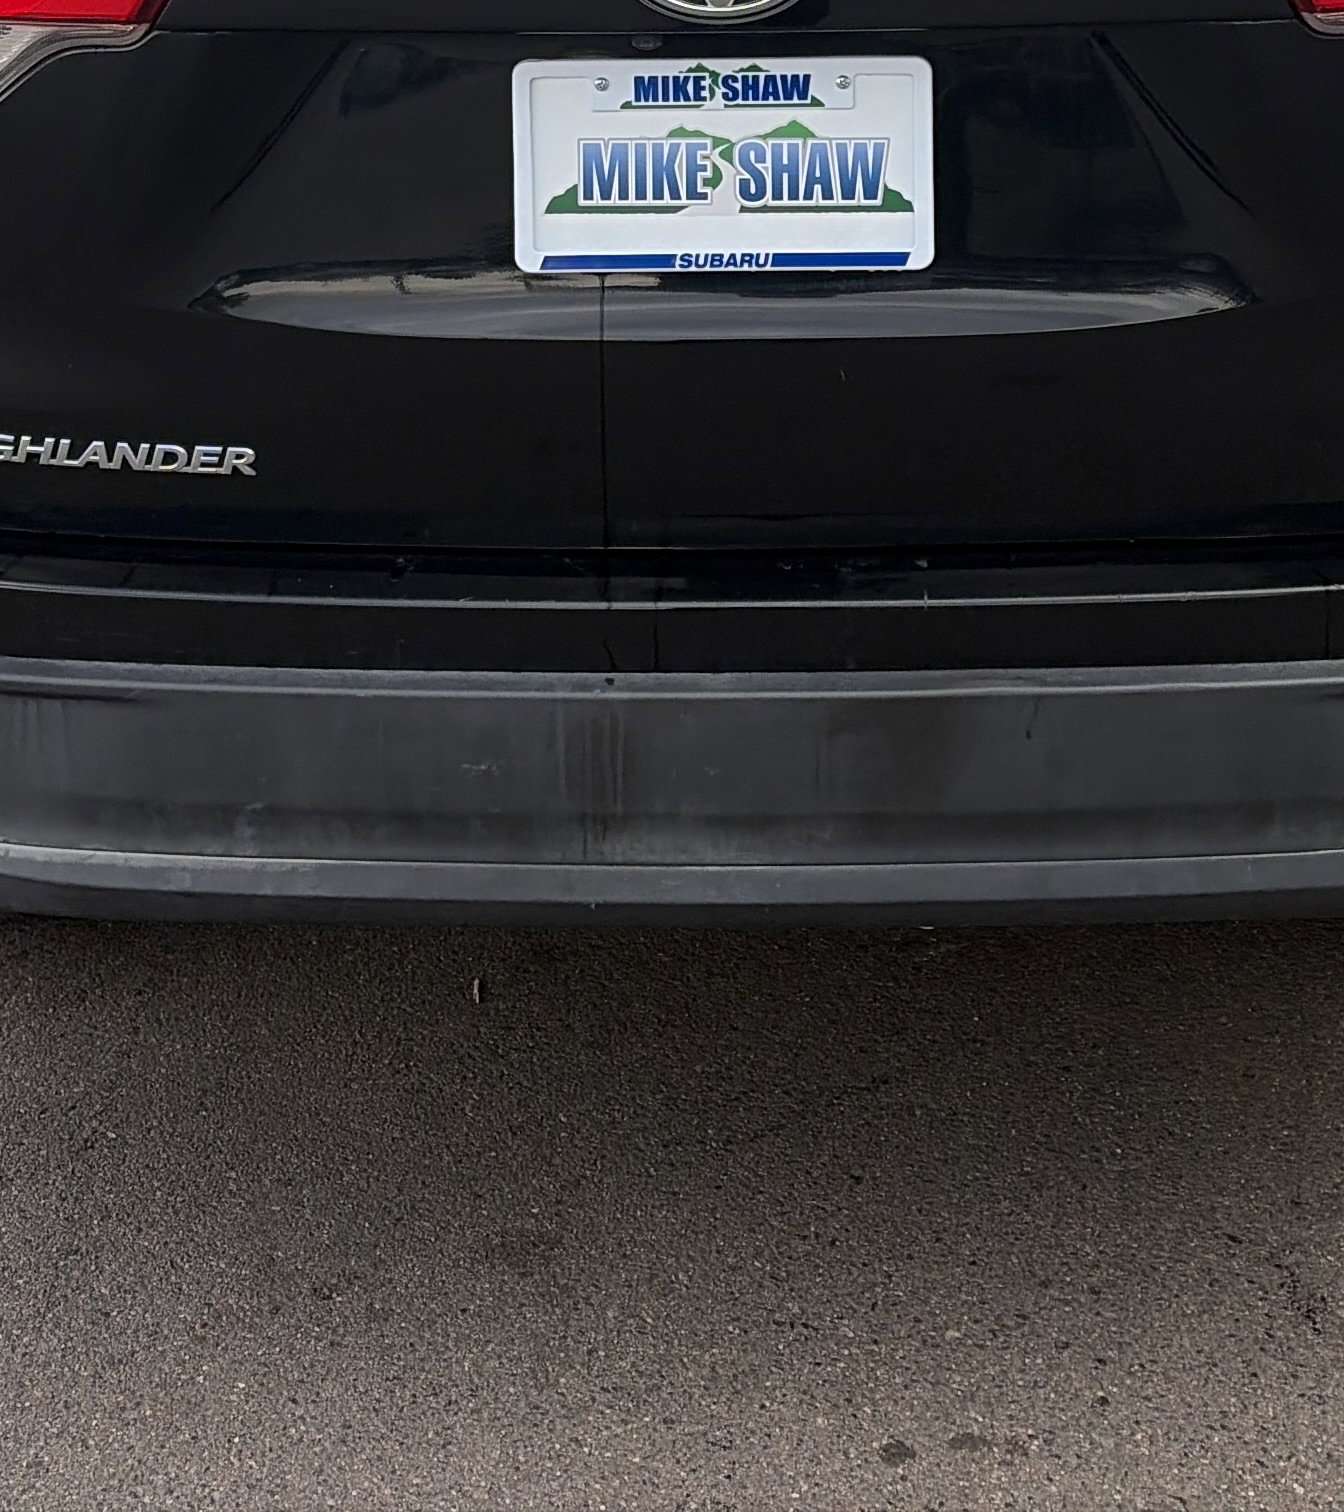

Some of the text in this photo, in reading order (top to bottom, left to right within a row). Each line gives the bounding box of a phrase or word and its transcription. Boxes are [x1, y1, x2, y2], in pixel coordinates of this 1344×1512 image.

[633, 73, 811, 103] MIKE SHAW
[580, 139, 887, 204] MIKE SHAW
[678, 252, 772, 269] SUBARU
